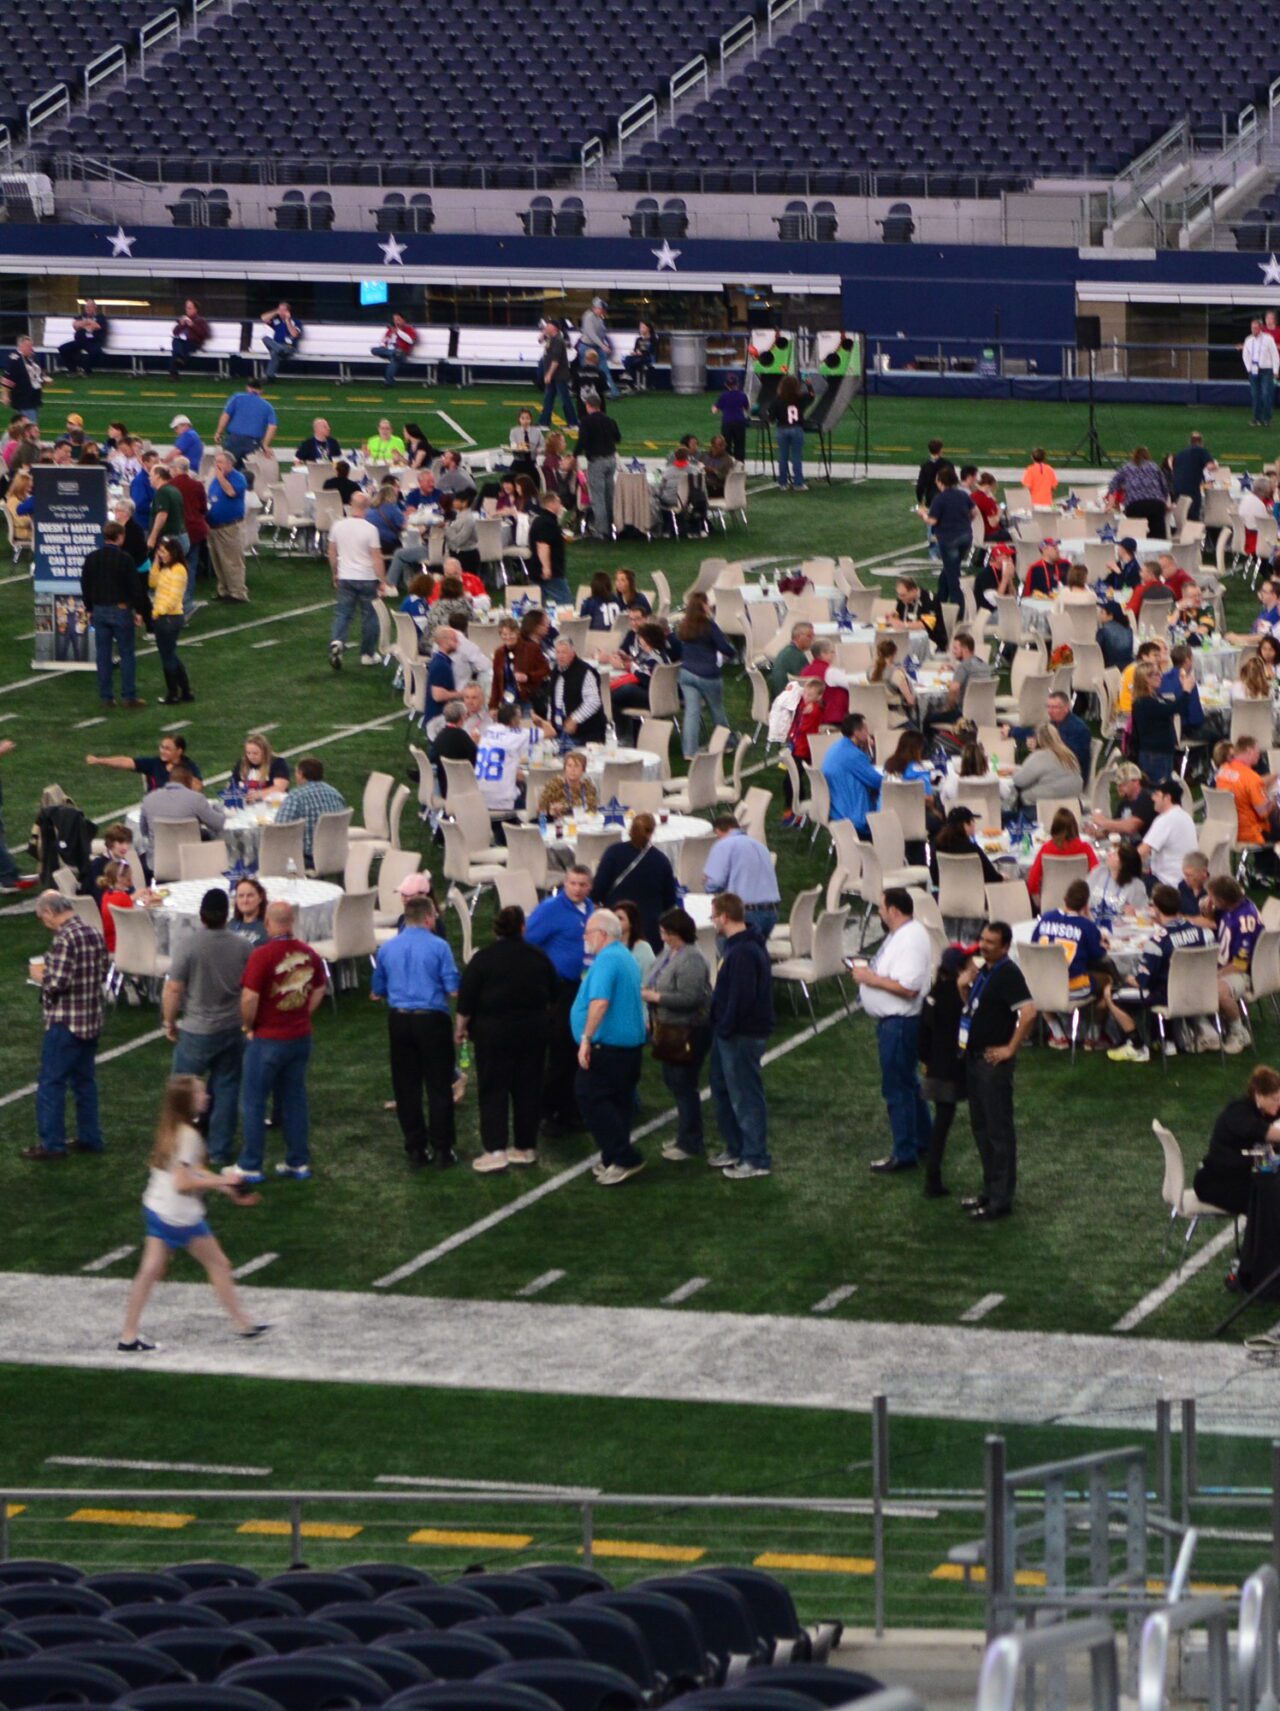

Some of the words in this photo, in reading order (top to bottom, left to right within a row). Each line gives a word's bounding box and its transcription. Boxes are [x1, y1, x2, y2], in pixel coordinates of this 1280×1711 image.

[38, 522, 69, 533] DOESN'T
[70, 522, 102, 534] MATTER
[44, 533, 71, 544] WHICH
[73, 534, 95, 545] CAME
[48, 555, 66, 566] CAN
[475, 746, 505, 782] 88
[1239, 916, 1256, 934] 10
[1170, 926, 1200, 949] BRADY
